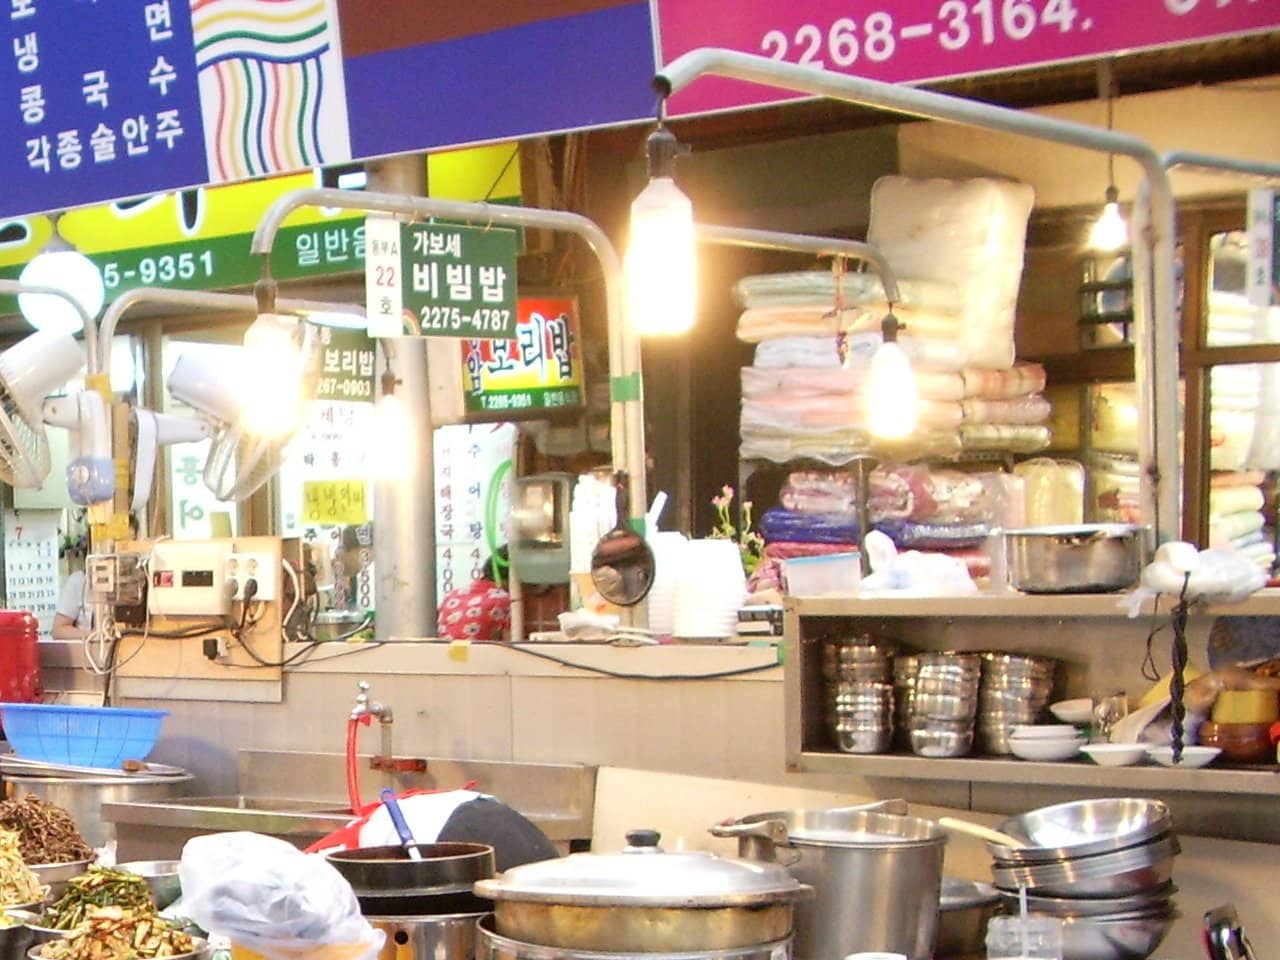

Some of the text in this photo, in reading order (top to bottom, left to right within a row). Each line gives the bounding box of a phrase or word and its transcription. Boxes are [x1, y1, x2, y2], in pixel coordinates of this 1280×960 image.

[20, 56, 177, 124] 콩국수
[413, 231, 462, 257] 가보세
[376, 265, 396, 287] 22
[413, 262, 506, 301] 비빔밥
[379, 296, 393, 315] 호
[421, 306, 510, 330] 2275-4787
[324, 349, 375, 377] 보리밥
